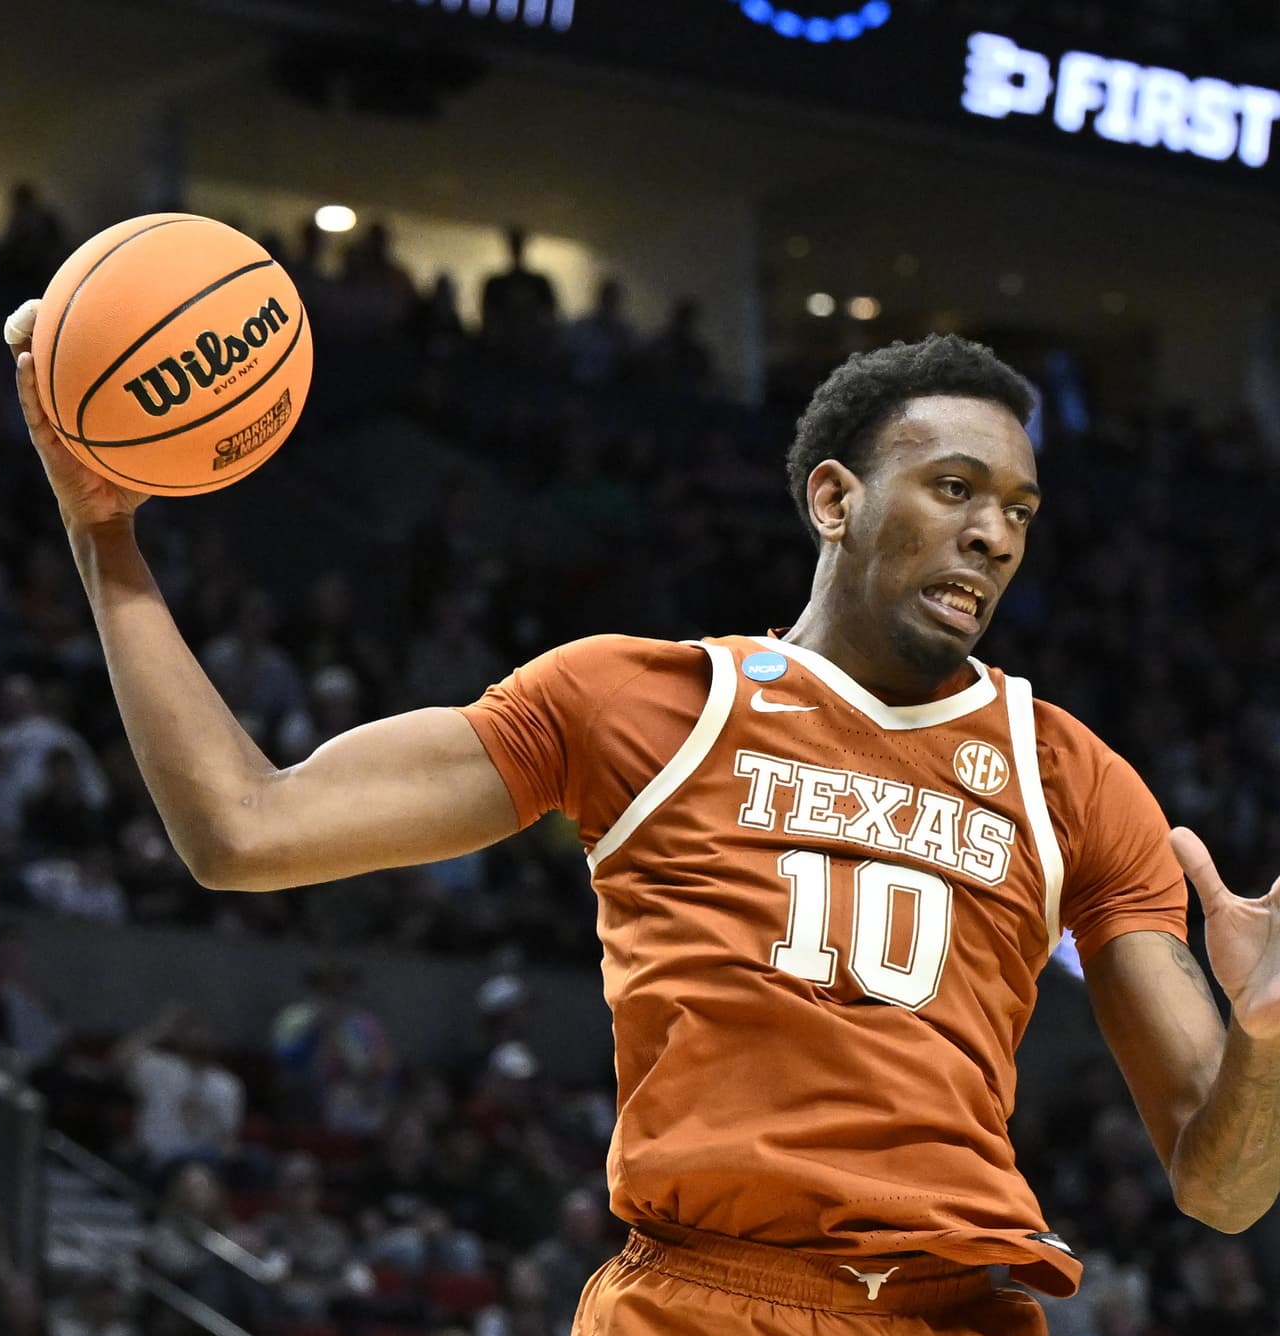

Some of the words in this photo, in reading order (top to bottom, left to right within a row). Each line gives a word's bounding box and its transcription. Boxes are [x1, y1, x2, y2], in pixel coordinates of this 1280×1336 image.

[123, 297, 289, 417] Wilson
[213, 376, 237, 396] EVO
[238, 357, 259, 377] NXT
[231, 409, 275, 447] MARCH
[748, 663, 785, 674] NCAA
[957, 744, 1009, 794] SEC
[734, 749, 1016, 887] TEXAS
[770, 849, 954, 1012] 10
